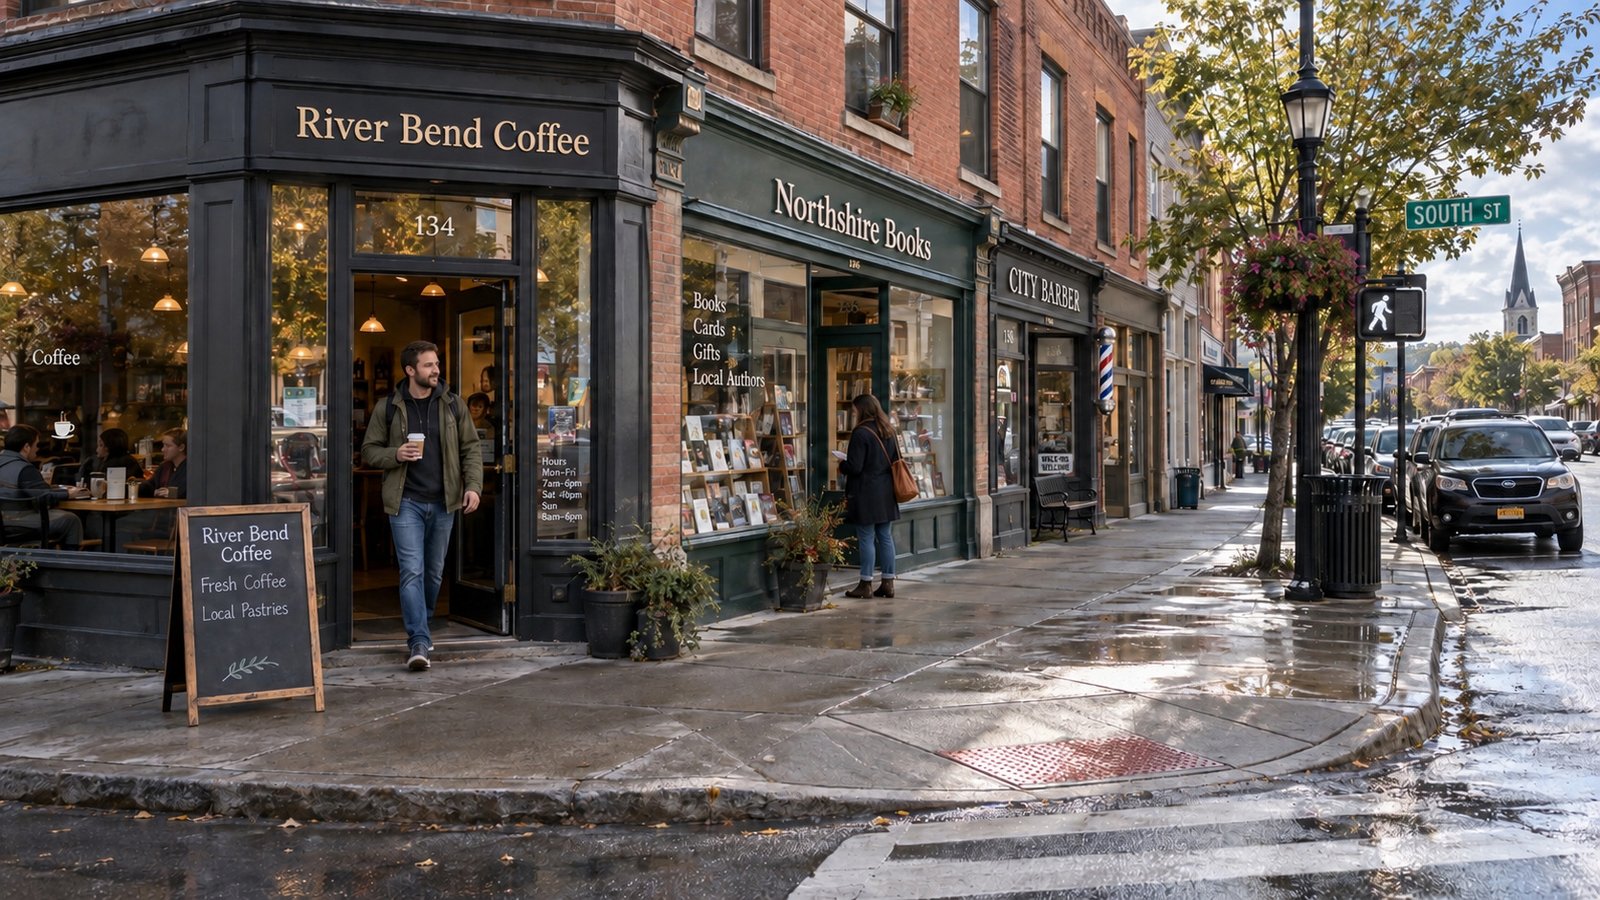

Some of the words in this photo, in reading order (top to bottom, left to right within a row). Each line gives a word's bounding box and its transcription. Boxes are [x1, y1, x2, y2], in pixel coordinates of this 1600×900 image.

[296, 105, 388, 143] River
[400, 112, 483, 149] Bend
[494, 120, 590, 156] Coffee
[774, 178, 880, 244] Northshire
[885, 217, 932, 261] Books
[1414, 202, 1473, 225] SOUTH
[1483, 202, 1502, 221] ST
[415, 215, 455, 236] 134
[1009, 267, 1038, 299] CITY
[1041, 278, 1081, 312] BARBER
[693, 291, 727, 314] Books
[693, 317, 726, 338] Cards
[32, 348, 81, 366] Coffee
[693, 343, 721, 361] Gifts
[693, 368, 723, 386] Local
[727, 370, 766, 388] Authors
[542, 457, 567, 466] Hours
[542, 468, 576, 476] Mon-Fri
[542, 479, 582, 489] 7am-6pm
[541, 501, 558, 510] Sun
[541, 512, 583, 523] 8am-6pm
[202, 527, 244, 544] River
[249, 524, 289, 541] Bend
[221, 544, 273, 563] Coffee
[201, 576, 237, 593] Fresh
[243, 573, 287, 590] Coffee
[202, 605, 236, 621] Local
[241, 602, 289, 618] Pastries
